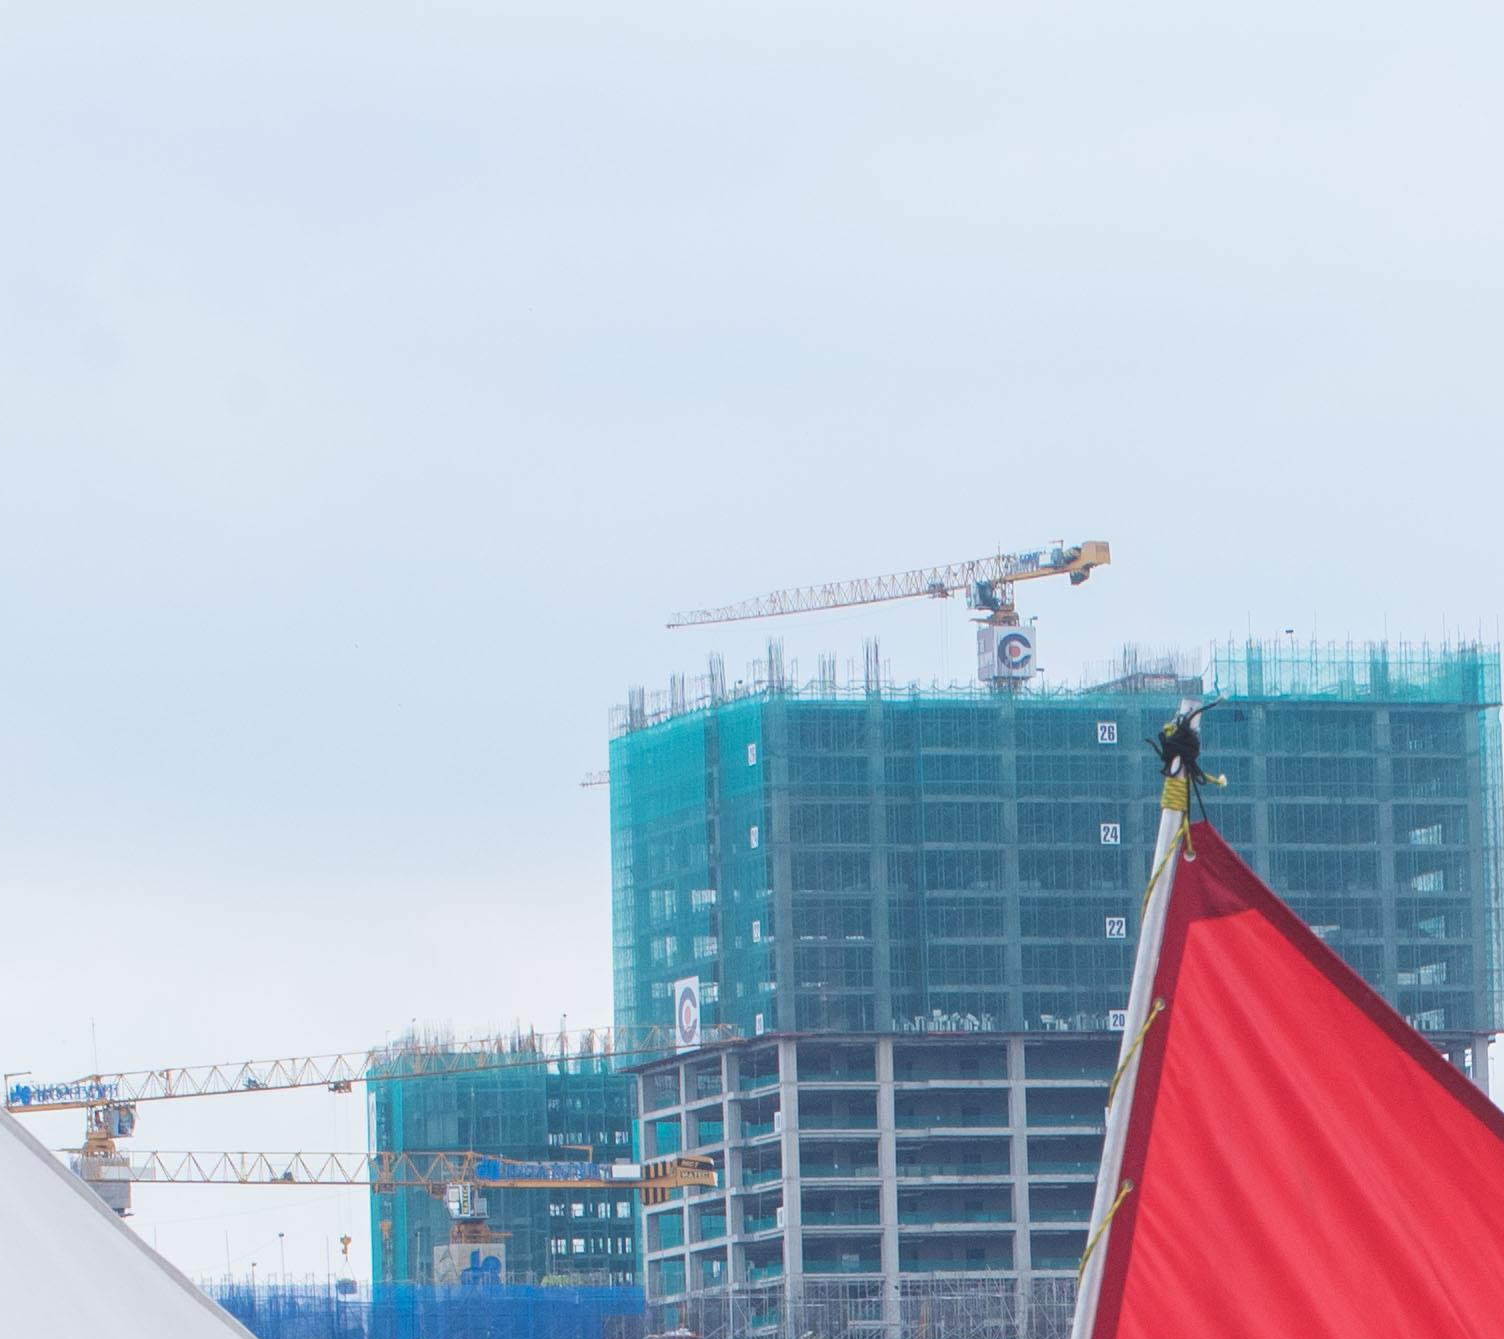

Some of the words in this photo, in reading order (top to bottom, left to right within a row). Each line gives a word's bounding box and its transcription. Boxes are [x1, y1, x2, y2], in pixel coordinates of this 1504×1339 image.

[1099, 725, 1115, 741] 26
[1102, 826, 1118, 842] 24
[1108, 919, 1124, 937] 22
[1112, 1013, 1125, 1027] 20
